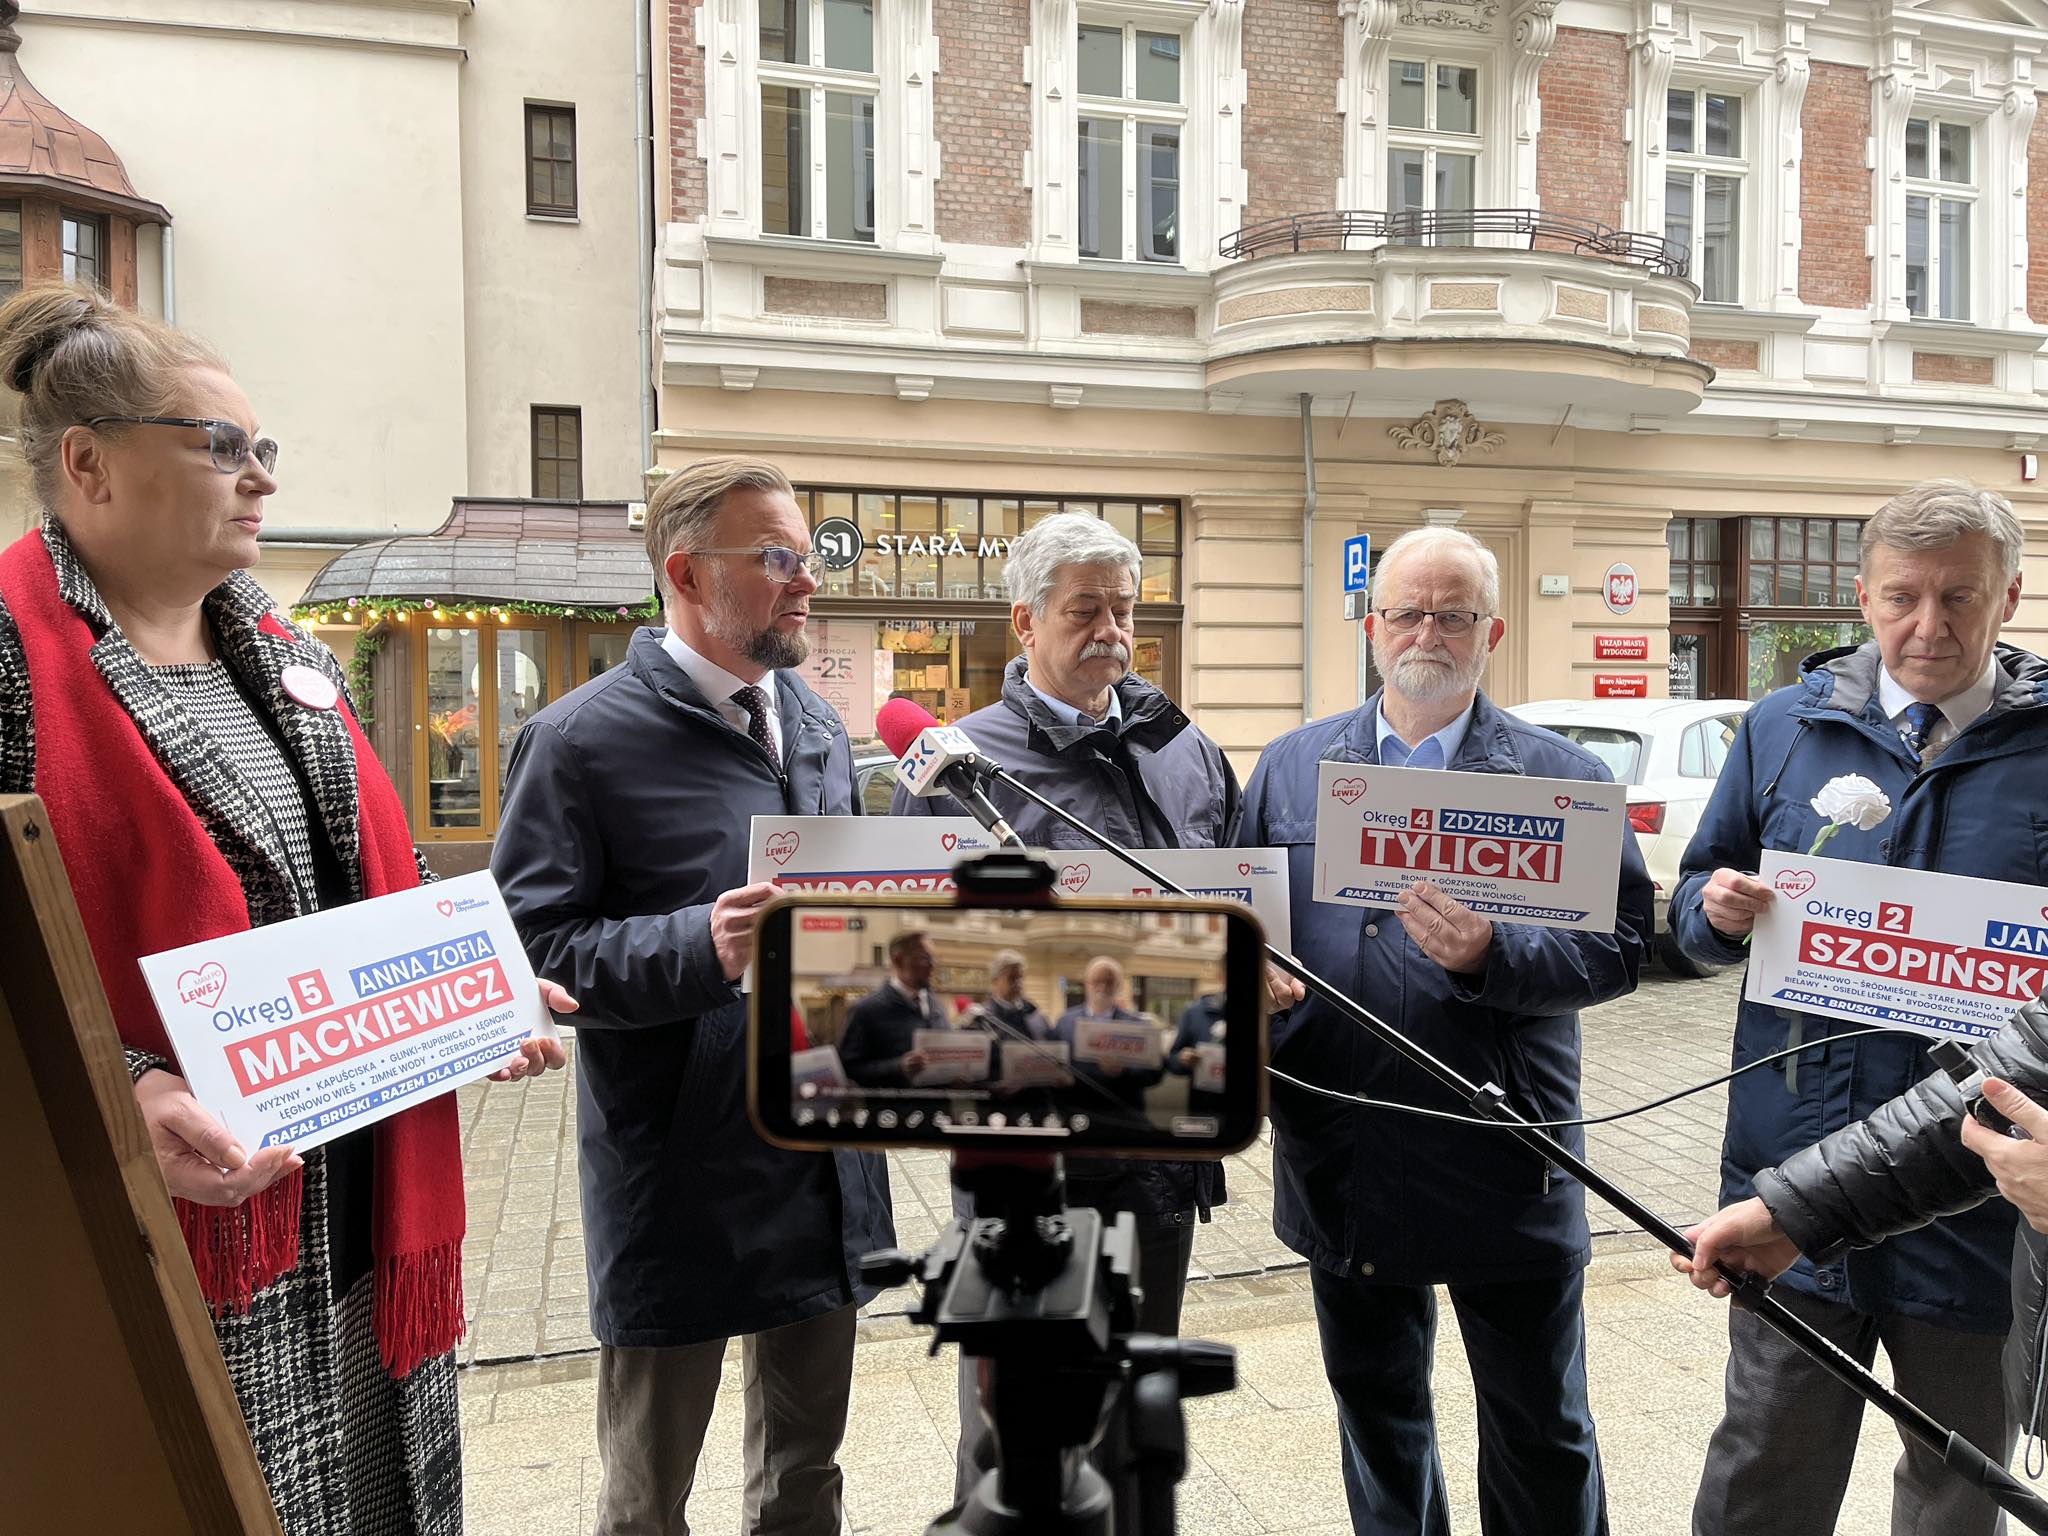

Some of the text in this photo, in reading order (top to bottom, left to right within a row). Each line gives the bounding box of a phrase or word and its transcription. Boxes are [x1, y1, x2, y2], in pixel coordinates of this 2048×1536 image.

[877, 534, 1014, 557] STARA MY
[1348, 543, 1362, 586] P
[1600, 640, 1621, 648] URZĄD
[1602, 648, 1642, 656] BYDGOSZCZY
[1332, 788, 1360, 797] LEWEJ
[1363, 810, 1560, 838] Okręg 4 ZDZISŁAW
[766, 845, 792, 857] LEWEJ
[1367, 829, 1559, 882] TYLICKI
[781, 878, 958, 896] BYDGOSZC
[1061, 876, 1084, 886] LEWEJ
[1438, 877, 1499, 891] GÓRZYSKOWO,
[1441, 886, 1480, 898] WZGÓRZE
[1482, 890, 1526, 902] WOLNOŚCI
[1774, 880, 1806, 890] LEWEJ
[1345, 888, 1381, 900] RAFAŁ
[1475, 902, 1499, 912] DLA
[1501, 905, 1580, 921] BYDGOSZCZY
[1806, 900, 2048, 952] Okręg 2 JAN
[180, 980, 220, 1004] LEWEJ
[213, 935, 493, 1032] Okręg 5 ANNA ZOFIA
[1784, 975, 2004, 1022] BIELAWY OSIEDLE LEŚNE BYDGOSZCZ WSCHÓD
[1797, 969, 1851, 985] BOCIANOWO
[1861, 979, 1918, 998] ŚRÓDMIEŚCIE
[1927, 992, 1955, 1004] STARE
[1957, 998, 1992, 1011] MIASTO
[238, 966, 504, 1087] MACKIEWICZ
[1784, 990, 1825, 1006] RAFAŁ
[1828, 998, 1878, 1016] BRUSKI
[1887, 1010, 1935, 1027] RAZEM
[1938, 1020, 1967, 1033] DLA
[256, 1010, 515, 1113] WYŻYNY KAPUŚCISKA GLINKI-RUPIENICA ŁĘGNOWO
[279, 1025, 508, 1120] ŁĘGNOWO WIEŚ ZIMNE WODY CZERSKO POLSKIE
[268, 1119, 317, 1147] RAFAŁ
[319, 1097, 371, 1127] BRUSKI
[381, 1075, 425, 1101] RAZEM
[427, 1065, 453, 1083] DLA
